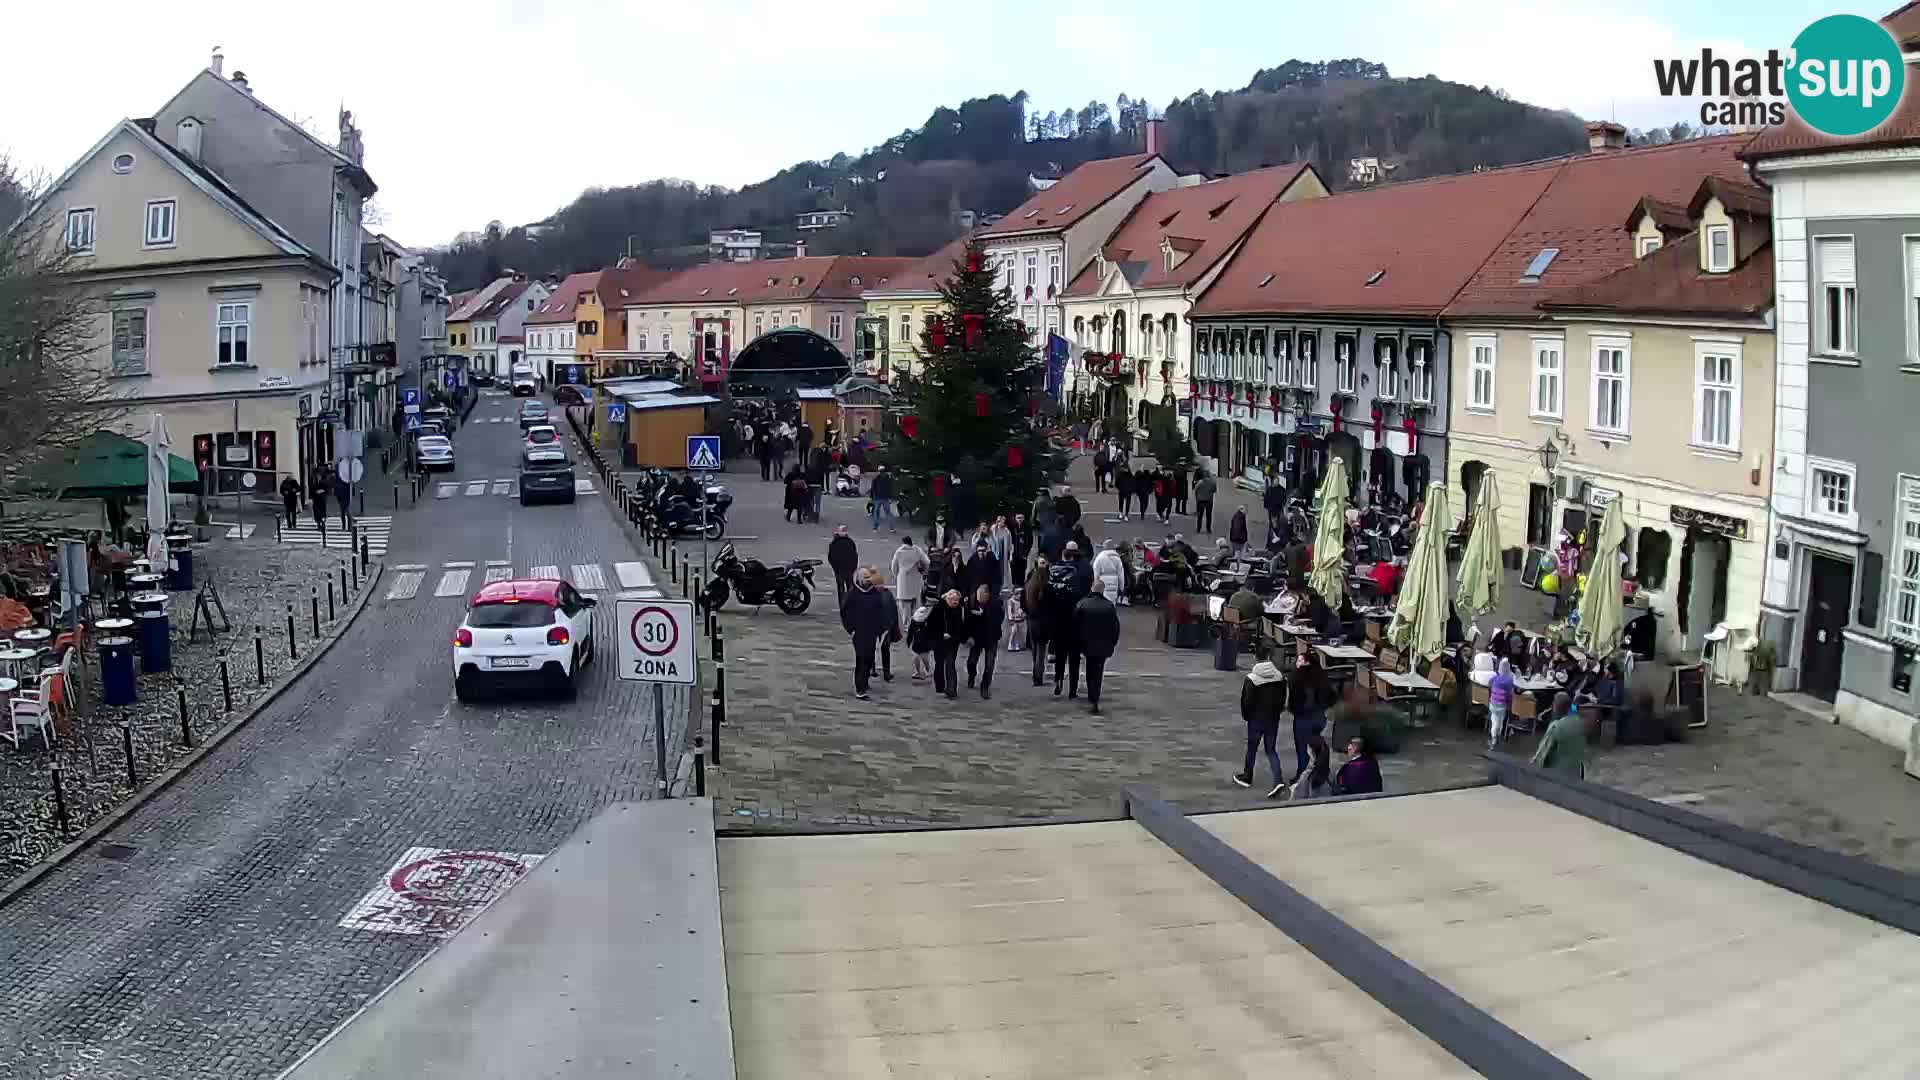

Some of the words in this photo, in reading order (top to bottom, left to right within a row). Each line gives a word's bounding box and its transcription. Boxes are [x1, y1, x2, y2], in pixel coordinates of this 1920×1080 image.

[407, 391, 416, 403] P
[643, 622, 667, 643] 30
[633, 659, 678, 677] ZONA
